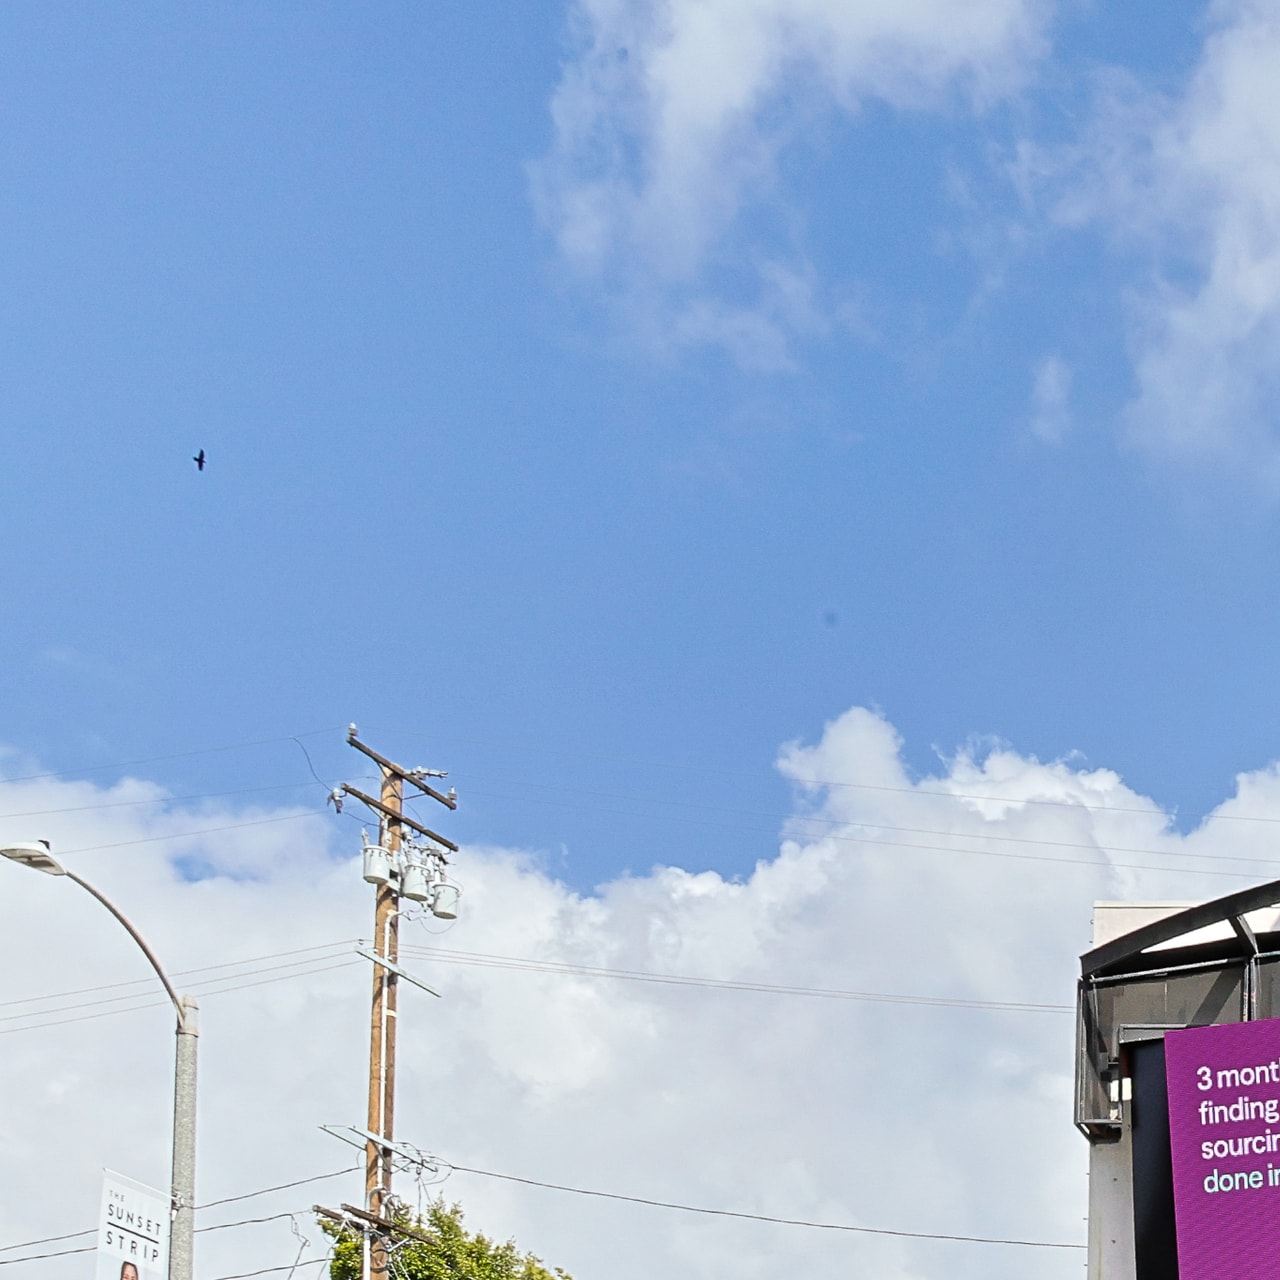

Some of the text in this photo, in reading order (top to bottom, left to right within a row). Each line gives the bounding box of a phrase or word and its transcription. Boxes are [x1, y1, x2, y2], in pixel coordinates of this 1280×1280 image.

[1196, 1066, 1213, 1091] 3
[1198, 1096, 1280, 1125] finding
[1203, 1168, 1264, 1193] done
[109, 1189, 125, 1203] THE
[107, 1204, 161, 1236] SUNSET
[106, 1231, 160, 1262] STRIP
